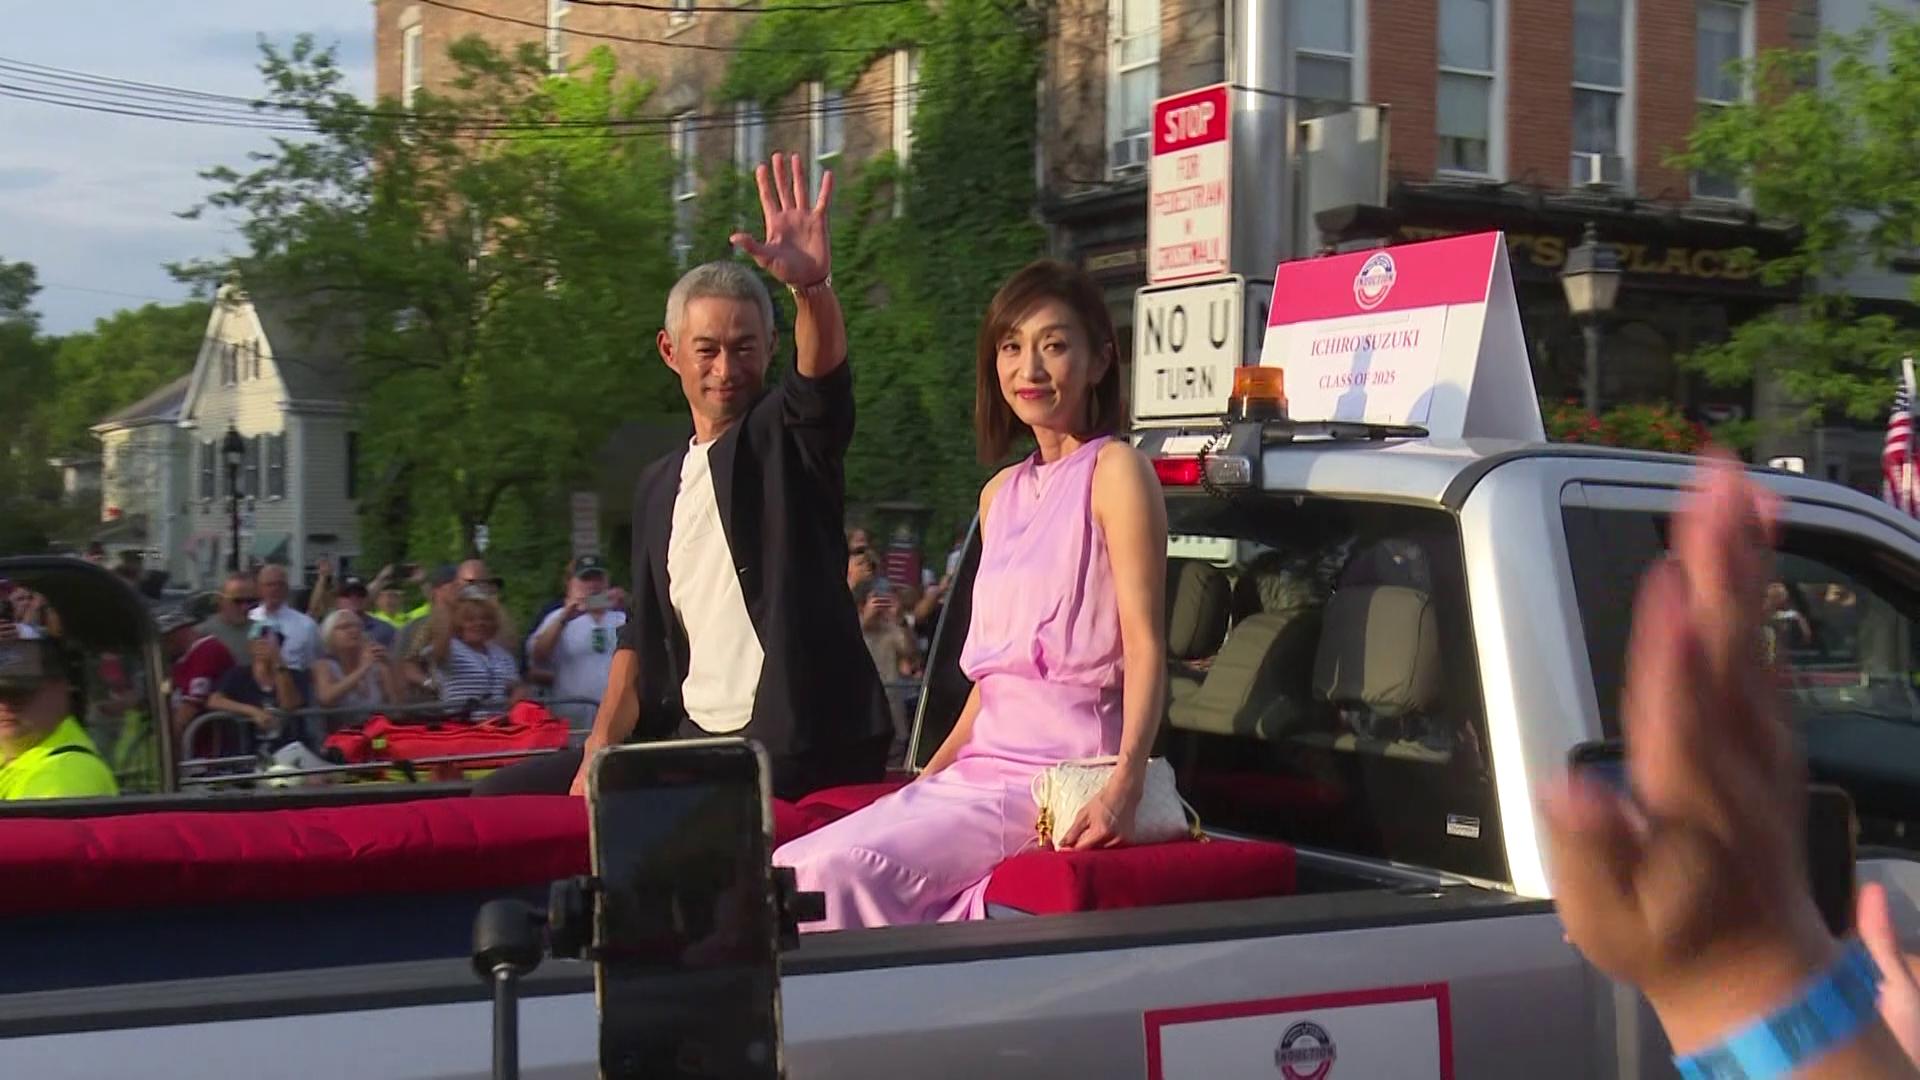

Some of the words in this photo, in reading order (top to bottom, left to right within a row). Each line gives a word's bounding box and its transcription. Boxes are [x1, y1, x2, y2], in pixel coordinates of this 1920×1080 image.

[1164, 101, 1215, 143] STOP
[1144, 304, 1187, 356] NO
[1208, 299, 1231, 350] U
[1311, 334, 1361, 356] ICHIRO
[1362, 328, 1420, 352] SUZUKI
[1156, 365, 1217, 401] TURN
[1319, 373, 1352, 389] CLASS
[1354, 371, 1368, 386] OF
[1372, 370, 1396, 385] 2025
[1274, 1042, 1337, 1067] INDUCTION
